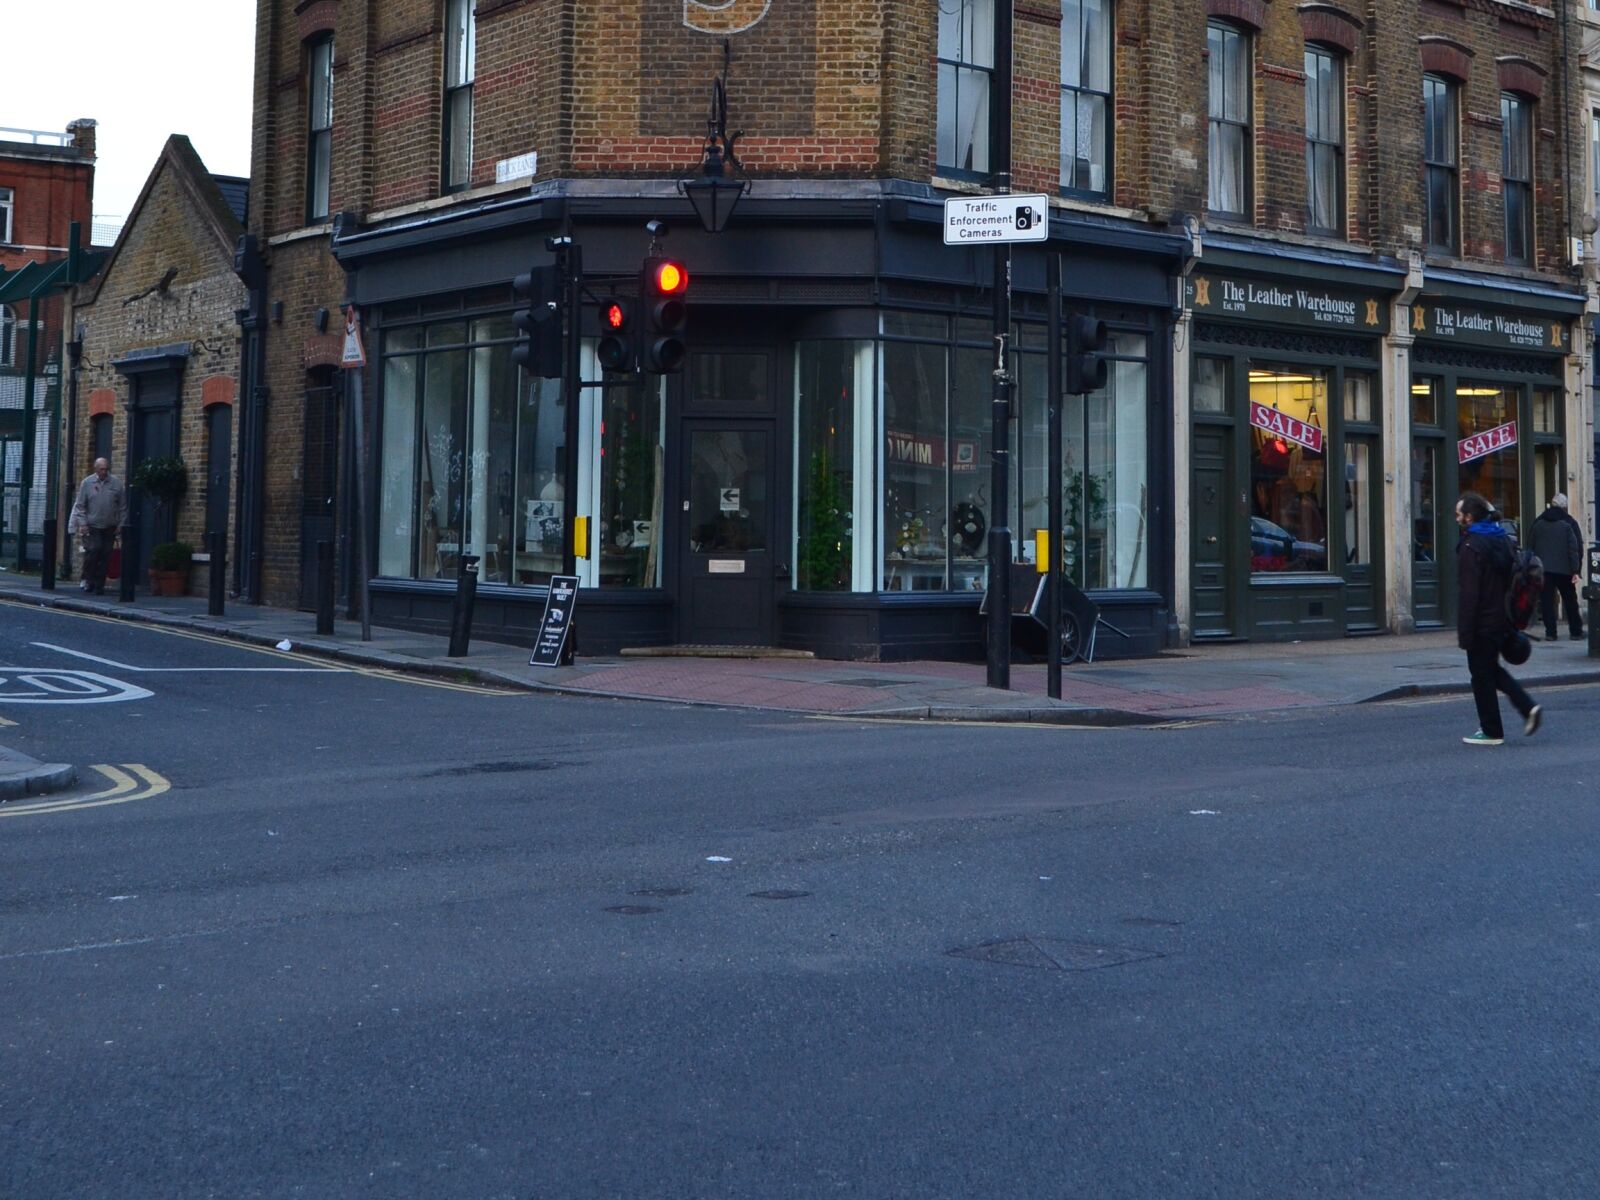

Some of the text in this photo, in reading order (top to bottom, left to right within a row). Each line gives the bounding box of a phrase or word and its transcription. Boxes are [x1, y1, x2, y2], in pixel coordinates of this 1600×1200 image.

[965, 203, 997, 212] Traffic
[950, 215, 1013, 226] Enforcement
[959, 229, 1002, 238] Cameras
[1222, 280, 1356, 314] The Leather Warehouse
[1223, 301, 1246, 312] Est. 1978
[1314, 312, 1323, 320] Tel.
[1434, 307, 1544, 338] The Leather Warehouse
[1256, 406, 1315, 446] SALE
[1463, 426, 1512, 459] SALE
